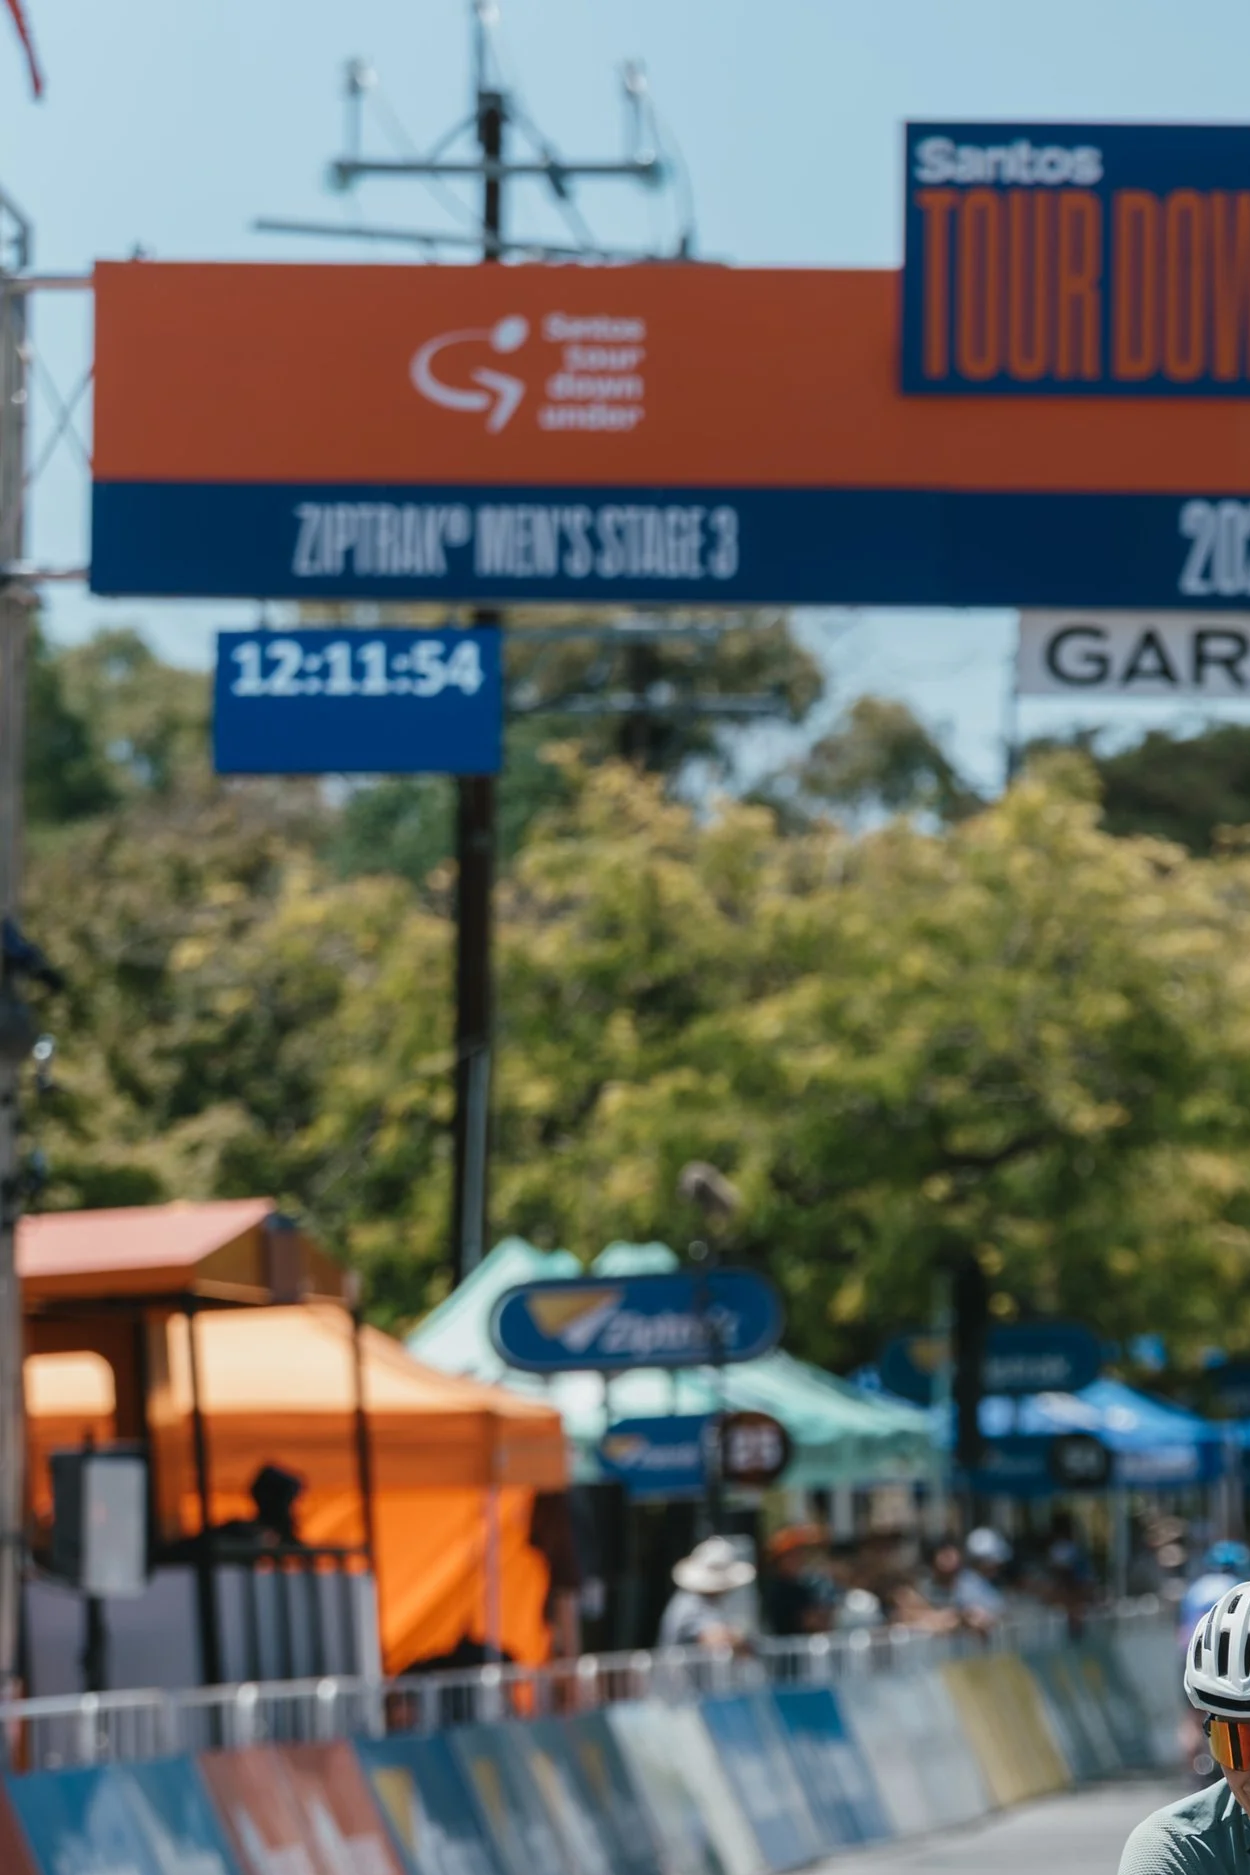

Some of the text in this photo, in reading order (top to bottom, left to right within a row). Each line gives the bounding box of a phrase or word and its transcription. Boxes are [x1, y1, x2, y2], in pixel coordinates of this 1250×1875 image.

[914, 136, 1103, 185] Santos
[916, 188, 1102, 379] TOUR
[474, 503, 593, 578] MEN'S
[597, 504, 705, 579] STAGE
[709, 505, 740, 580] 3
[231, 641, 483, 698] 12:11:54
